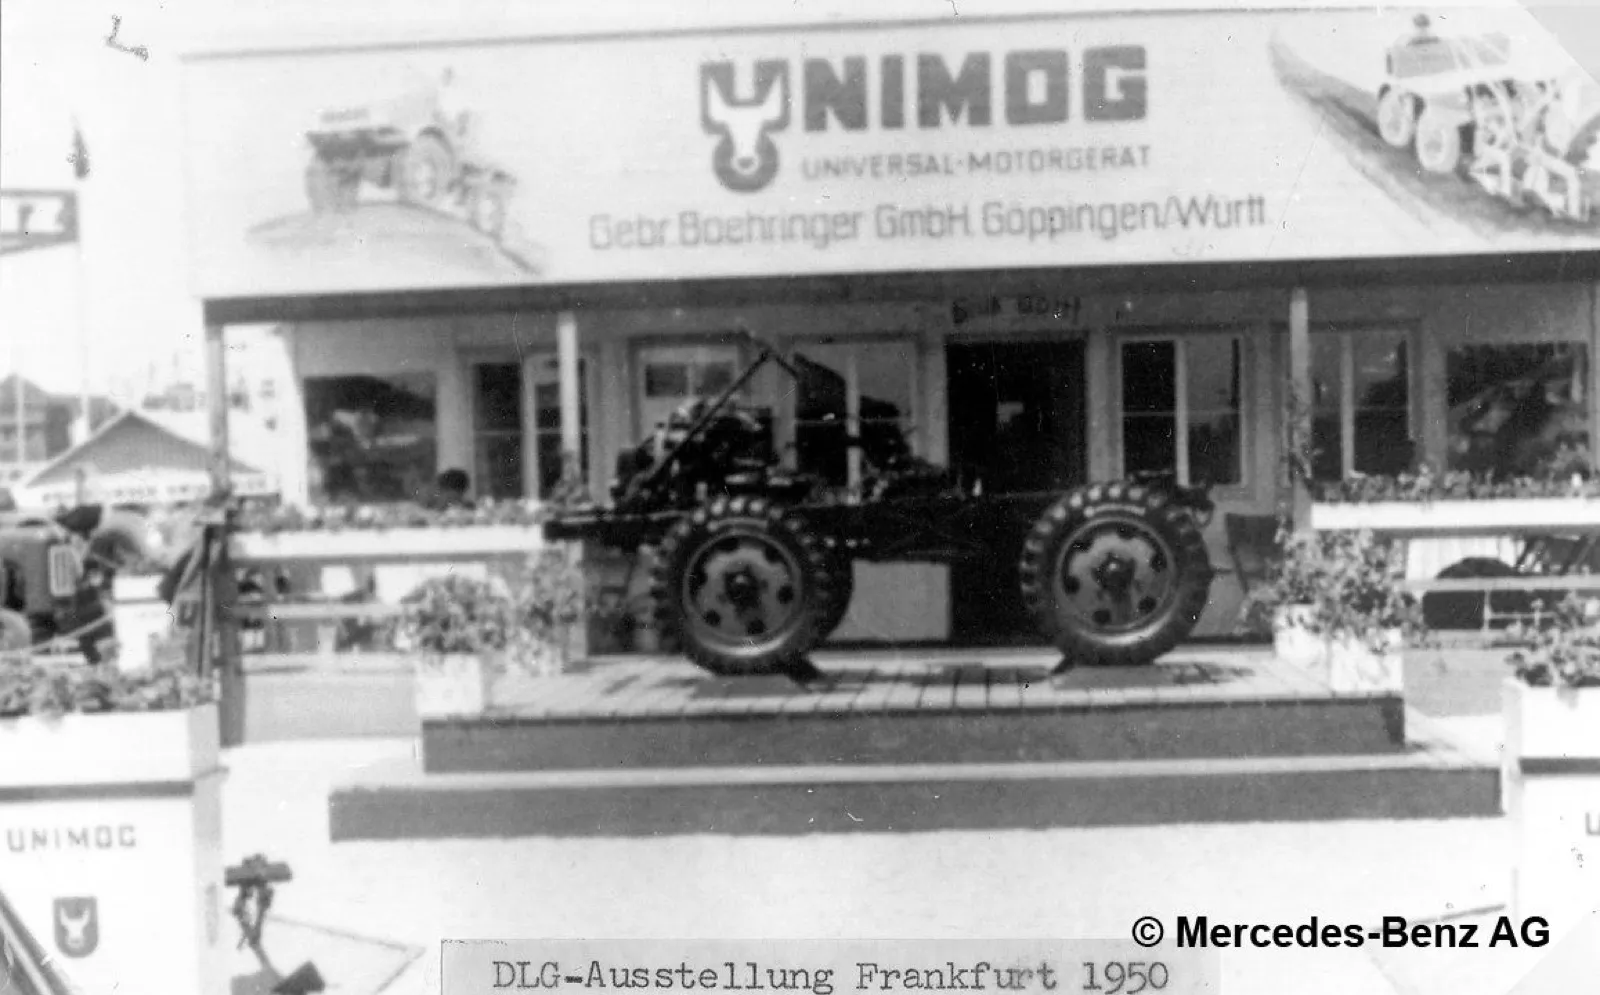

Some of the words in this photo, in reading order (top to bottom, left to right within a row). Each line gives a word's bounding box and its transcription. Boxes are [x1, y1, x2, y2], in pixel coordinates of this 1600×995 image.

[700, 45, 1149, 192] UNIMOG
[678, 207, 864, 249] Boehringer
[6, 825, 137, 853] UNIMOG
